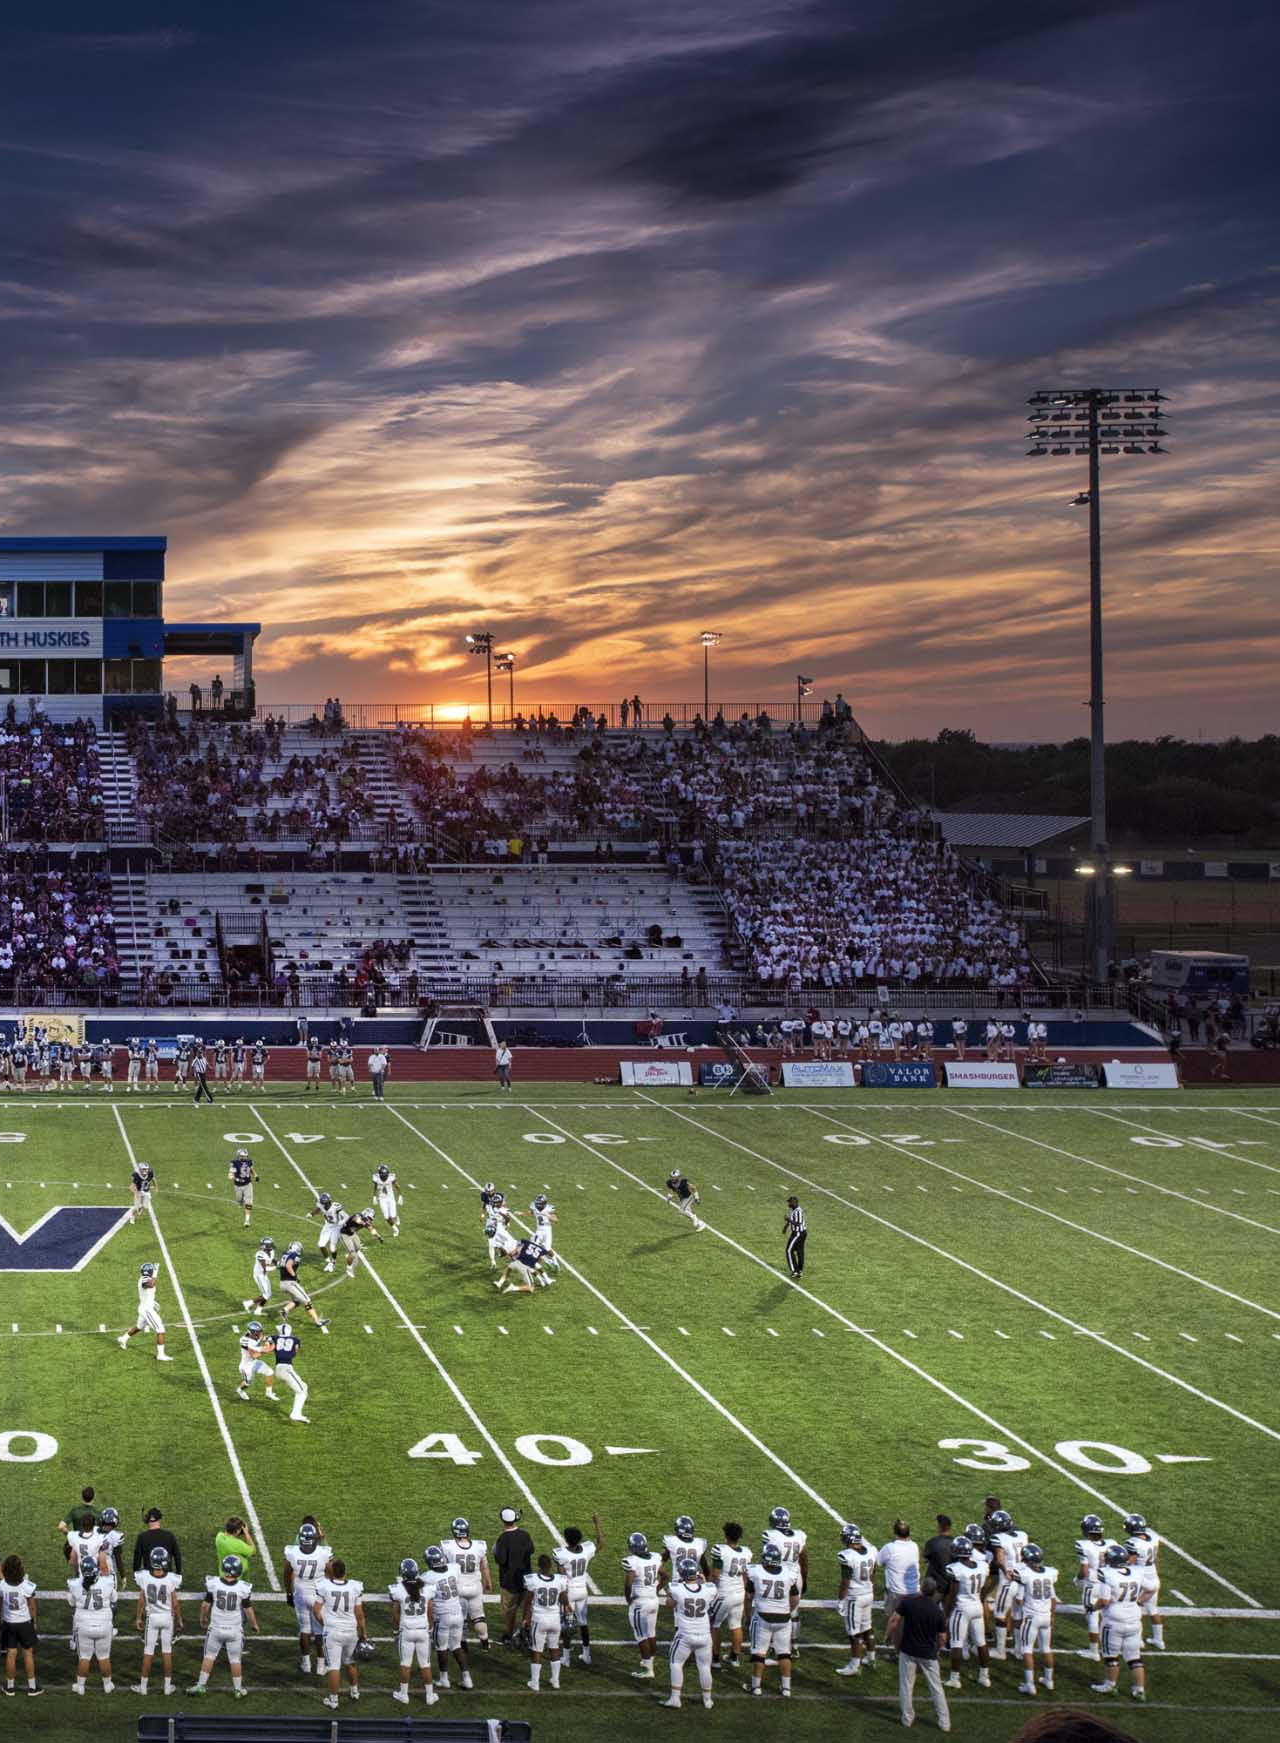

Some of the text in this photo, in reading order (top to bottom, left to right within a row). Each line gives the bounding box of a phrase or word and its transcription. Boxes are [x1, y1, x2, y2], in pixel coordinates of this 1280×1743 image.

[24, 631, 90, 647] HUSKIES
[888, 1067, 930, 1075] VALOR
[949, 1072, 1016, 1080] SMASHBURGER
[525, 1243, 542, 1258] 55
[296, 1559, 318, 1580] 77
[456, 1553, 476, 1574] 56
[569, 1558, 587, 1578] 10
[146, 1583, 167, 1604] 94
[761, 1579, 785, 1600] 76
[969, 1573, 982, 1595] 11
[1117, 1580, 1138, 1603] 72
[82, 1588, 103, 1610] 75
[331, 1590, 350, 1613] 71
[404, 1596, 426, 1617] 33
[683, 1597, 706, 1618] 52
